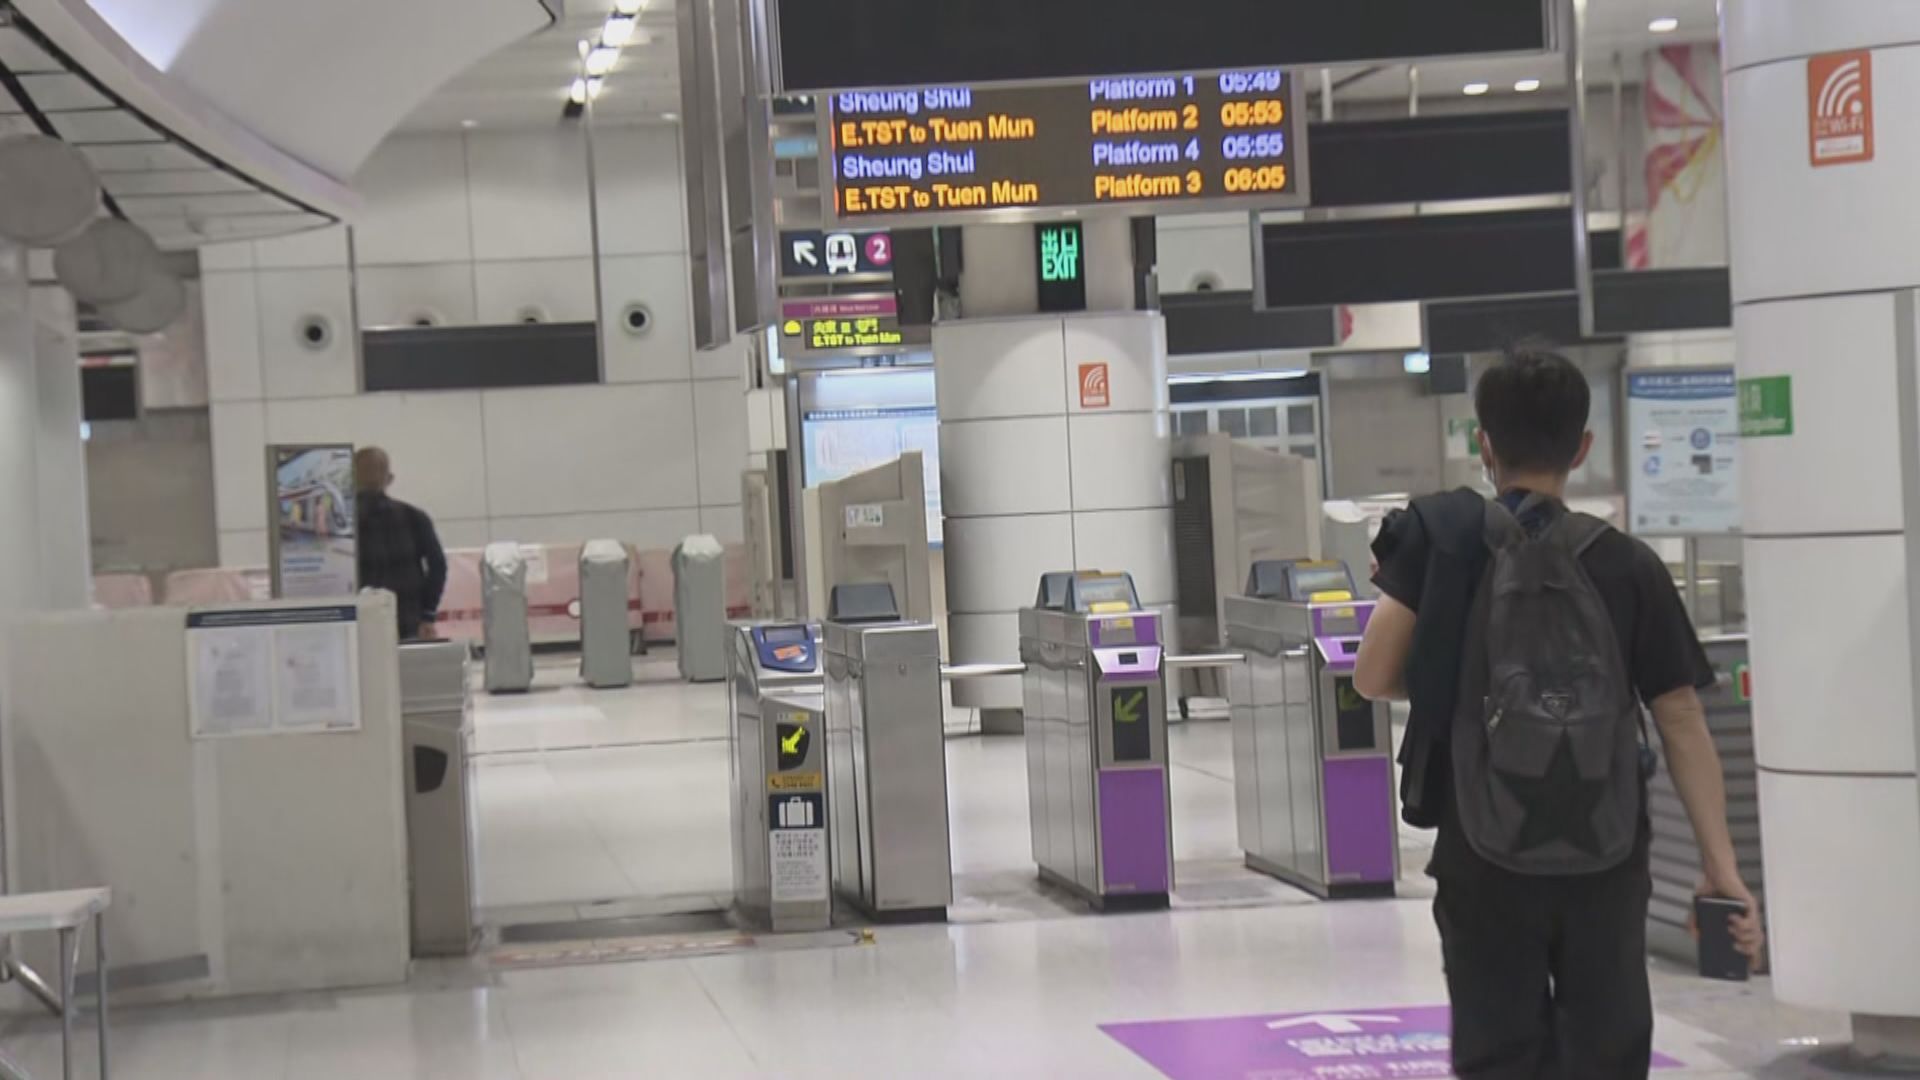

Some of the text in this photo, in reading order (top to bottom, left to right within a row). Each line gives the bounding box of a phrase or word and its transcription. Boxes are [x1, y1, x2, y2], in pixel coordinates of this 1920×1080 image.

[839, 90, 919, 115] Sheung
[1089, 78, 1176, 101] Platform
[1182, 76, 1194, 96] 1
[841, 100, 1283, 147] E.TST to Tuen Mun Platform 2 05:53
[843, 133, 1284, 179] Sheung Shui Platform 4 05:55
[845, 165, 1286, 212] E.TST to Tuen Mun Platform 3 06:05
[873, 239, 887, 259] 2
[1041, 227, 1078, 248] 出口
[1042, 247, 1076, 281] EXIT
